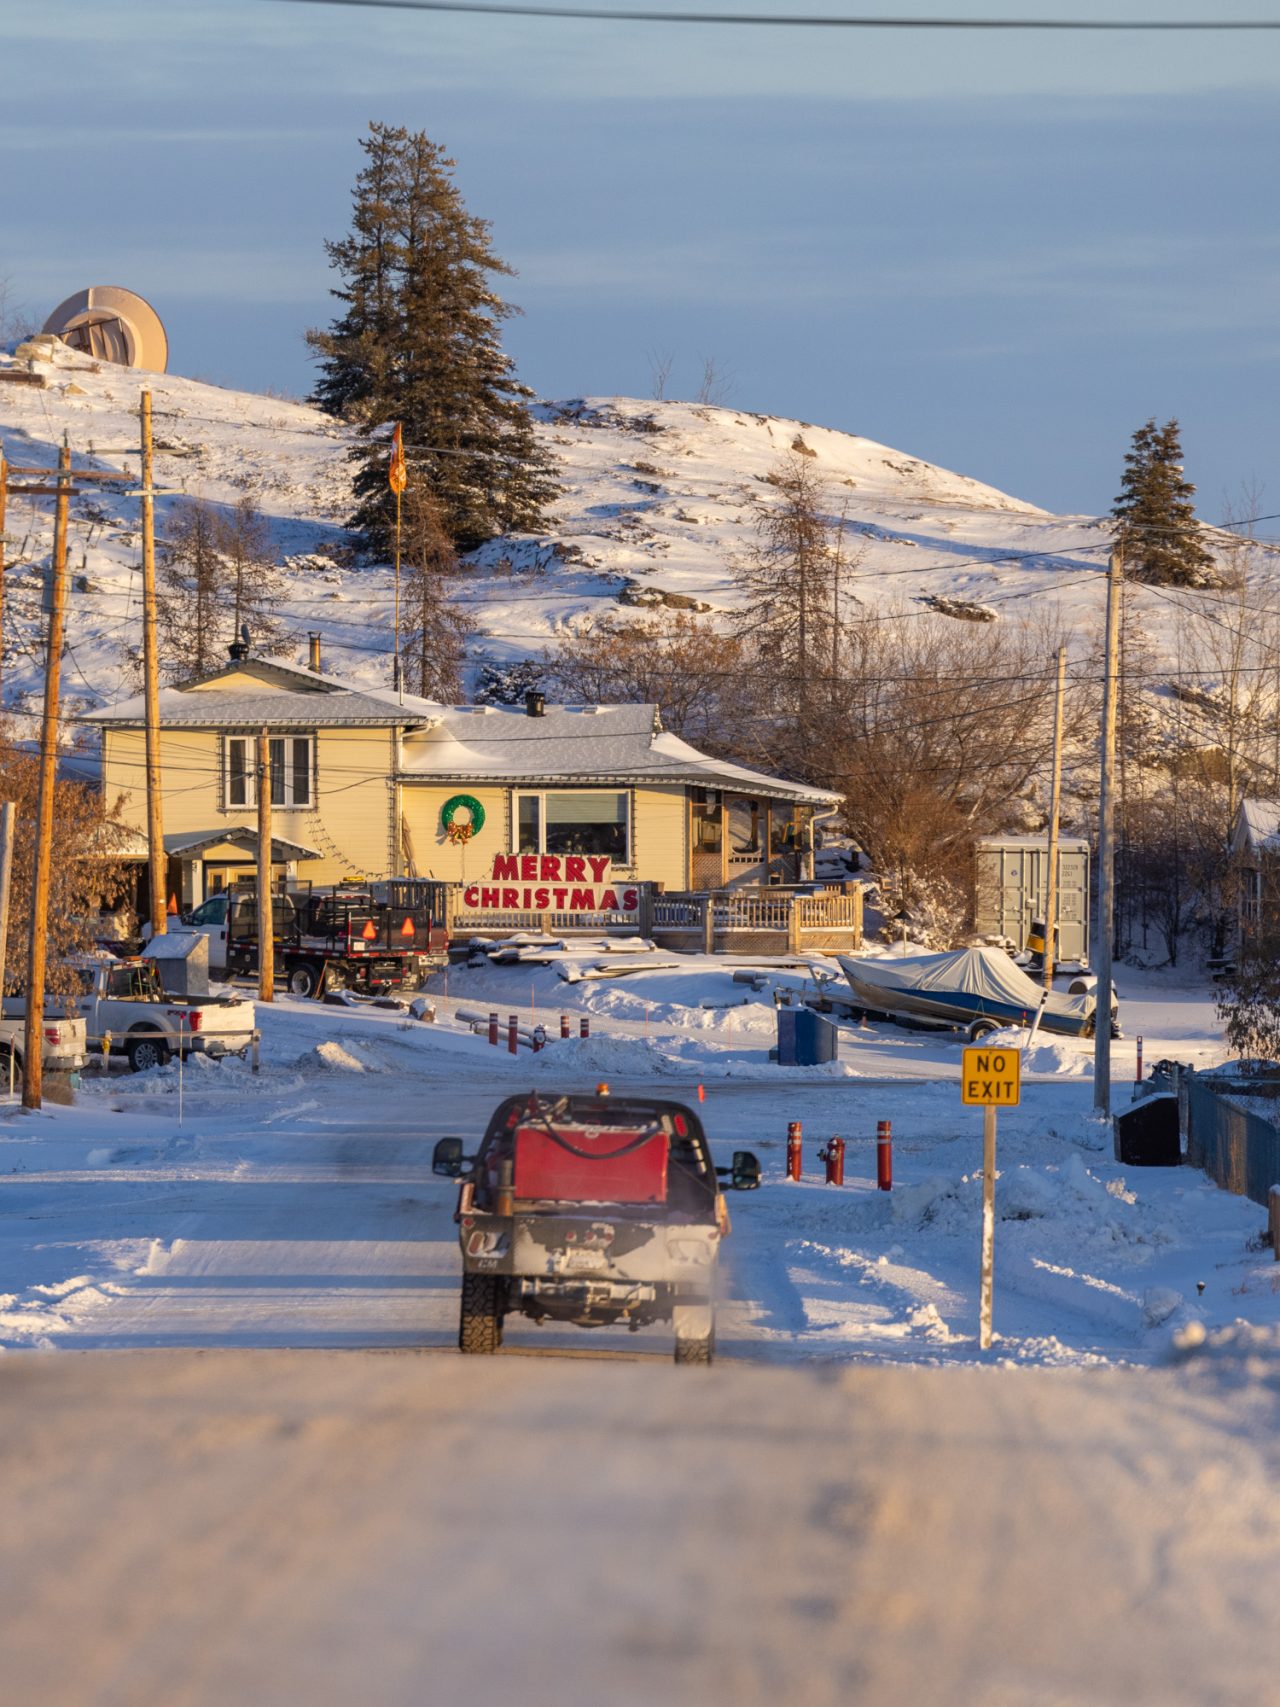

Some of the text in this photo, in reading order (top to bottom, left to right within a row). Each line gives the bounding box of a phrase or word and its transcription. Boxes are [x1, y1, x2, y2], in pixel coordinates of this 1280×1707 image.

[492, 855, 610, 883] MERRY
[464, 886, 639, 911] CHRISTMAS
[977, 1055, 1006, 1073] NO
[968, 1081, 1014, 1098] EXIT
